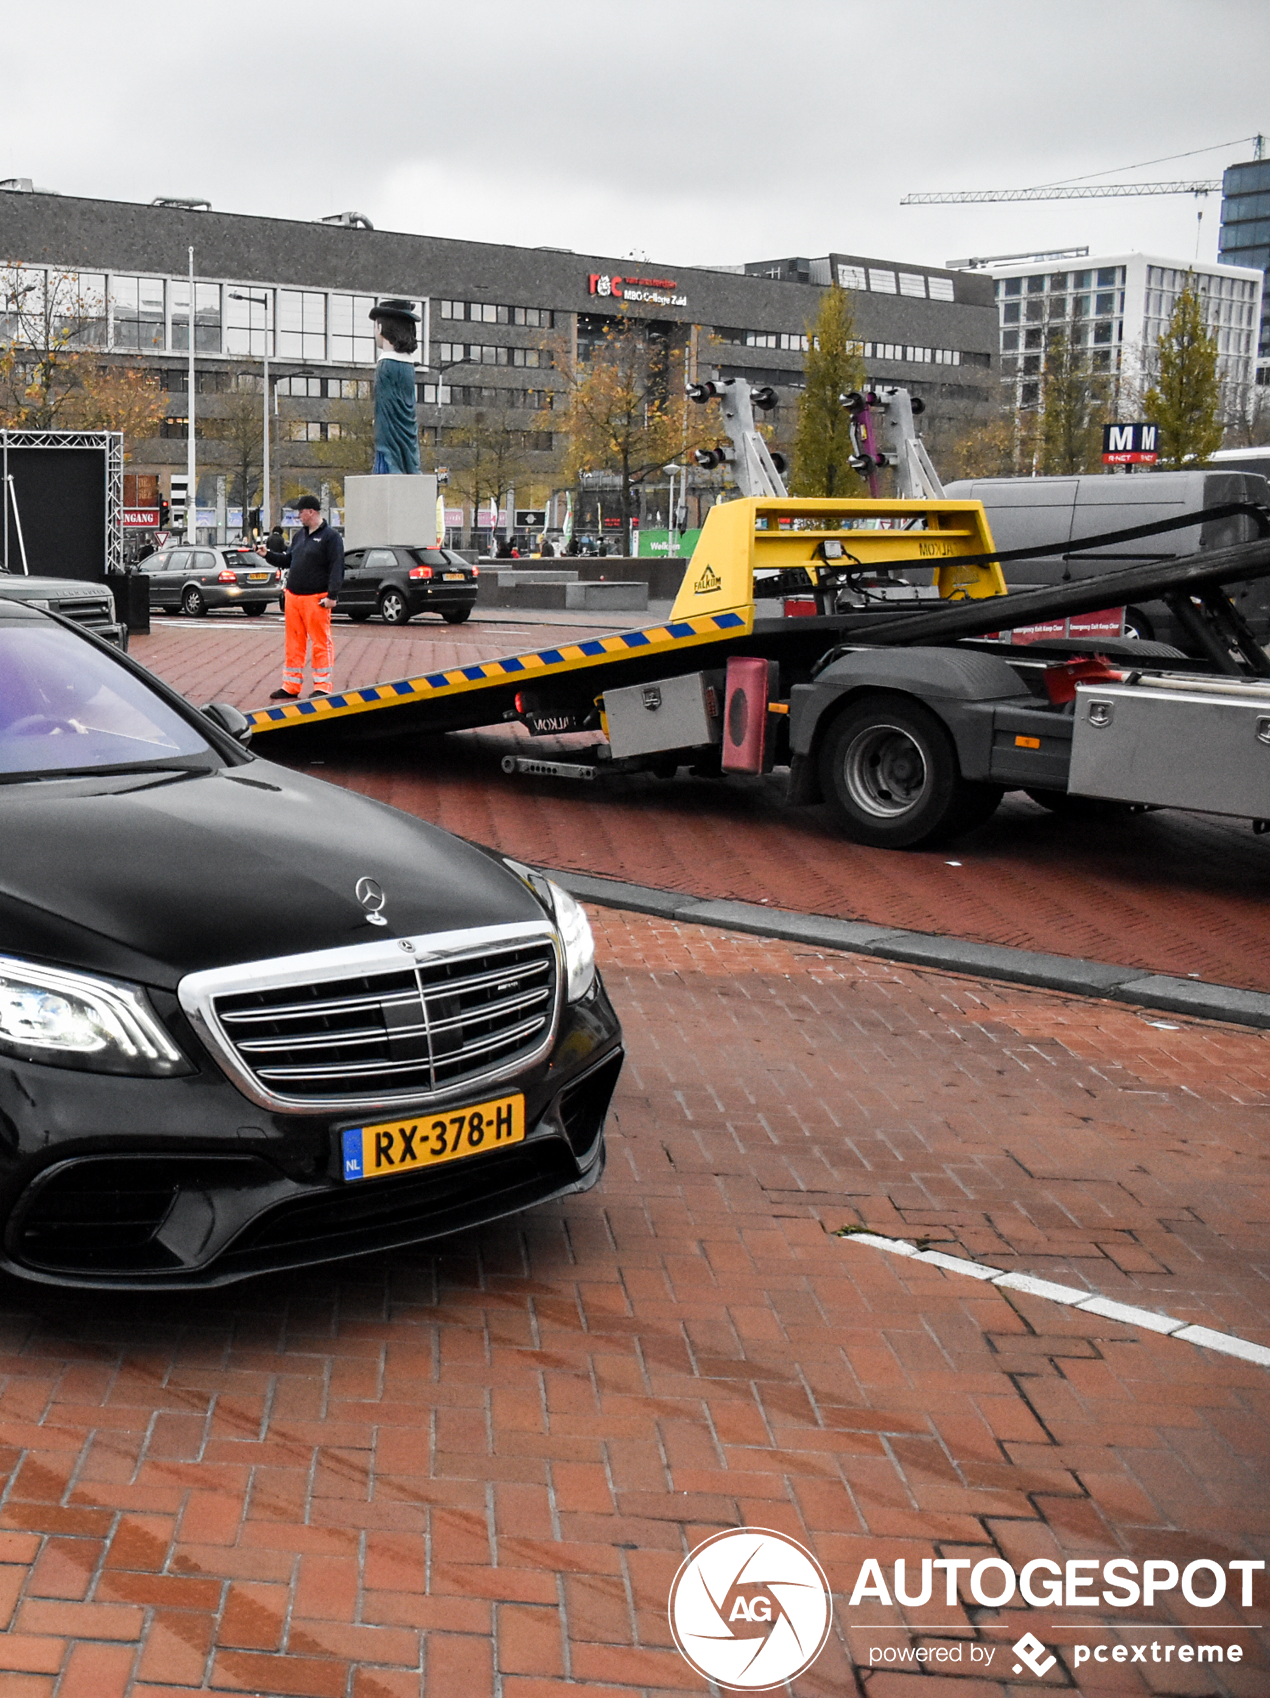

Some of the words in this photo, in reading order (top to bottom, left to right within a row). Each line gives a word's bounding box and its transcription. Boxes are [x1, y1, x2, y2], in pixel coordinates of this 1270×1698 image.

[623, 289, 643, 301] MBO
[1109, 426, 1133, 451] M
[1141, 426, 1156, 450] M
[375, 1103, 512, 1168] RX-378-H
[346, 1159, 360, 1172] NL
